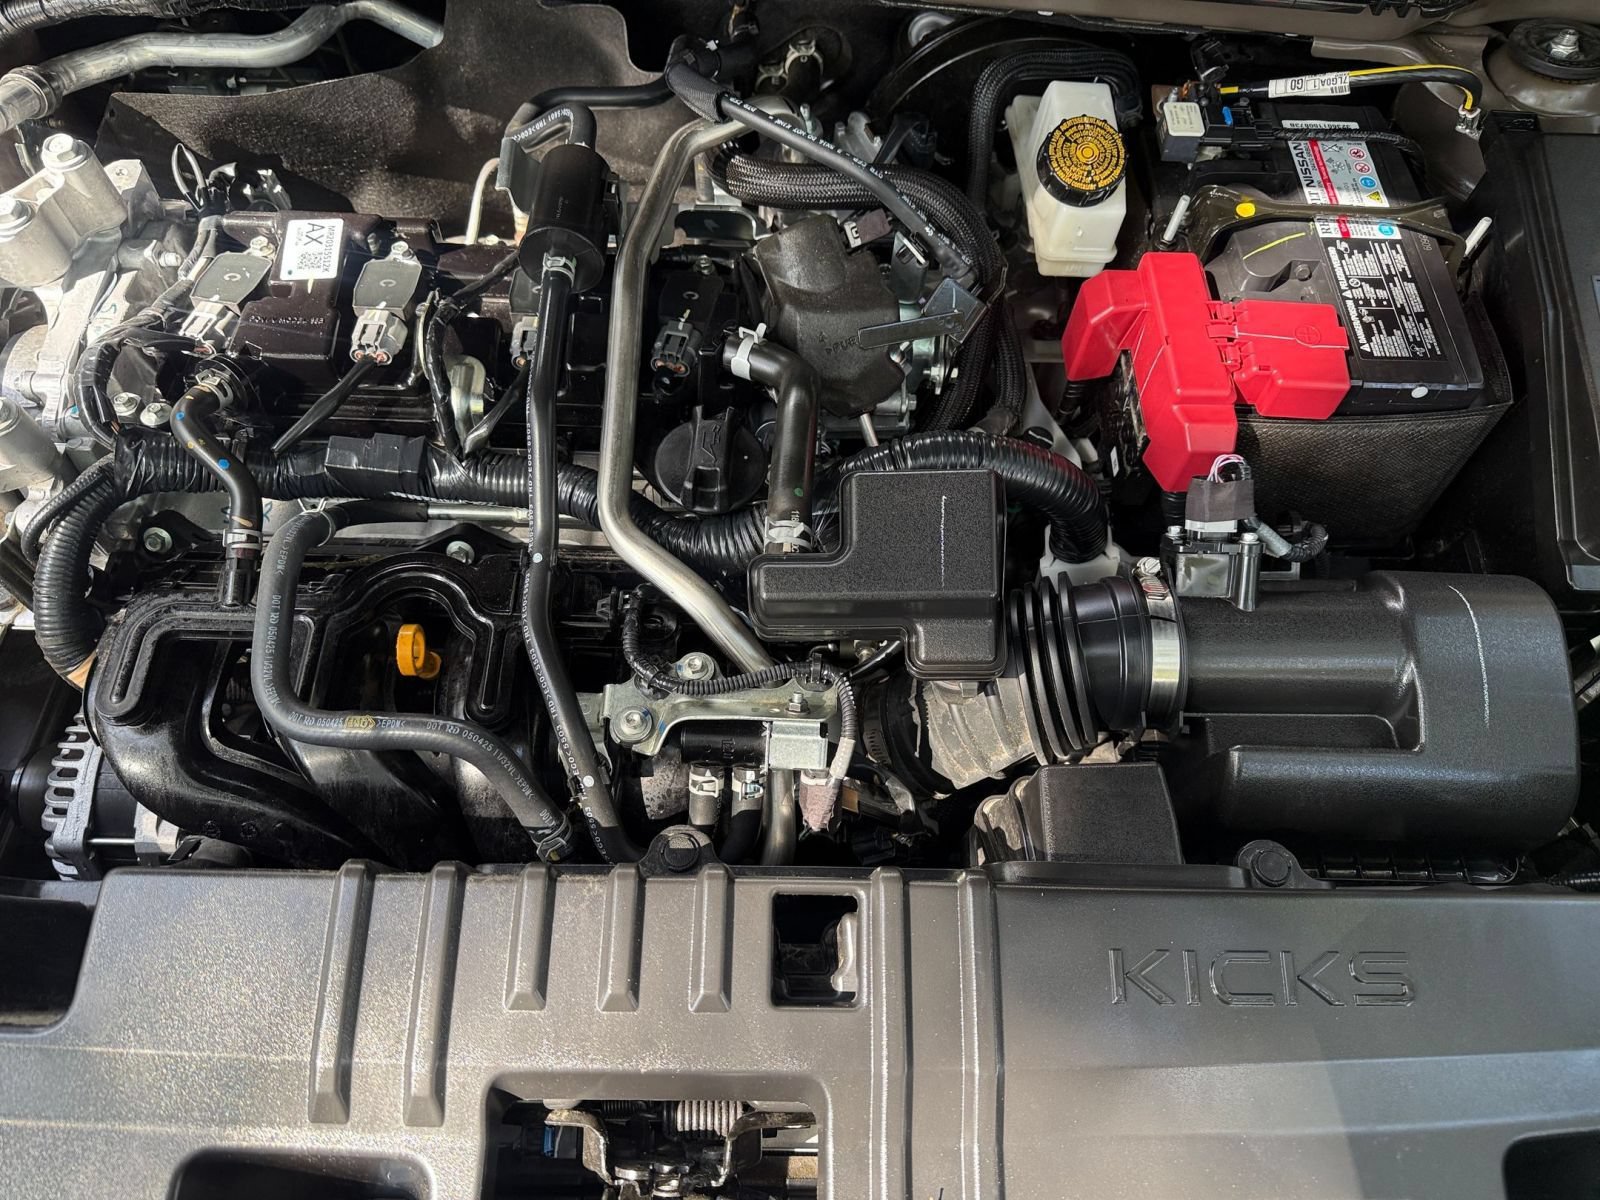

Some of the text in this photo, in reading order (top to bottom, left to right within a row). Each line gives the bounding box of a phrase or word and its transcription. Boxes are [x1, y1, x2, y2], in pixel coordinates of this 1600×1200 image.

[1293, 142, 1316, 188] NISSAN
[303, 222, 325, 246] AX
[1345, 300, 1367, 343] DANGER/POISON
[270, 593, 282, 610] DOT
[264, 625, 278, 655] 050425
[287, 710, 303, 722] DOT
[315, 716, 343, 727] 050425
[425, 720, 443, 732] DOT
[460, 728, 494, 752] 050425
[1108, 948, 1415, 1006] KICKS
